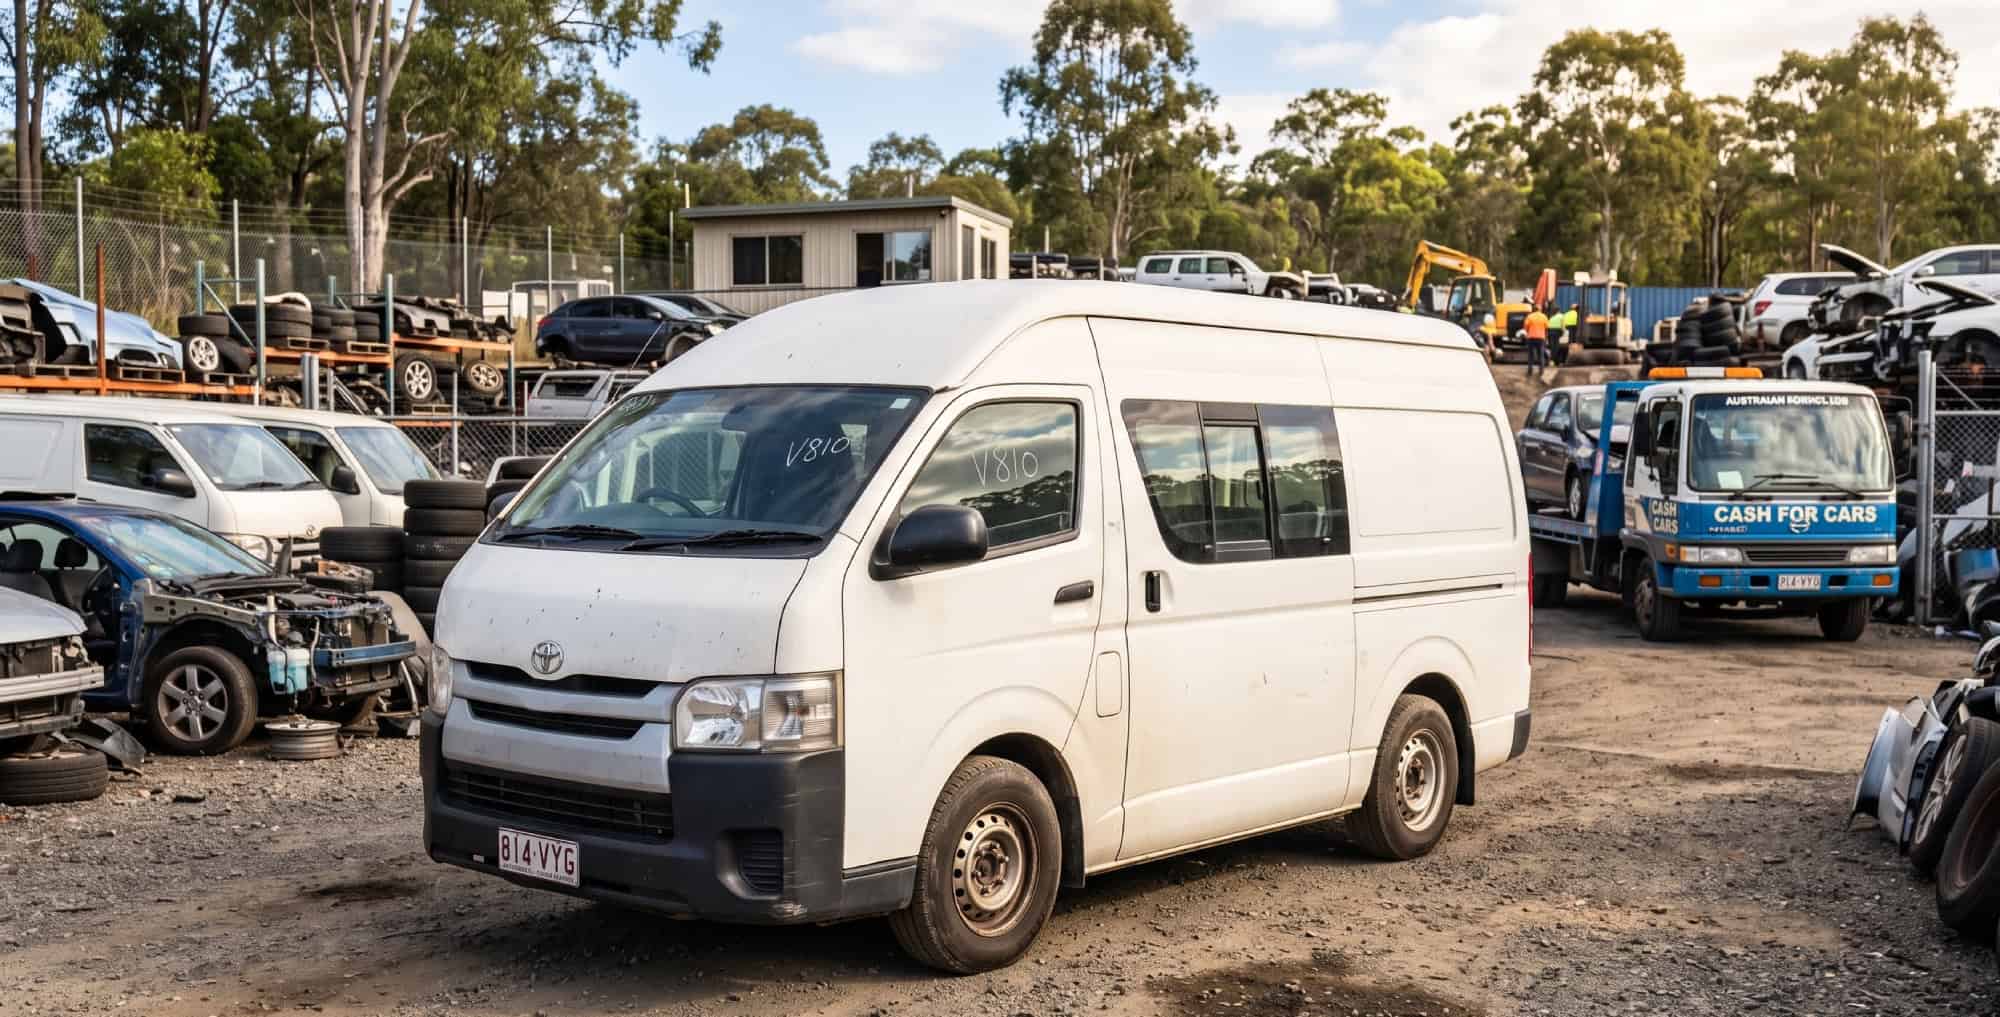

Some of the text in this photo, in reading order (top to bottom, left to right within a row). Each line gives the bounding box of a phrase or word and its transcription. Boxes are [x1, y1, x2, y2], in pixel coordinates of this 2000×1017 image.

[786, 437, 850, 467] V810
[970, 447, 1039, 489] V810
[1651, 500, 1678, 517] CASH
[1714, 505, 1878, 523] CASH FOR CARS
[1653, 517, 1679, 535] CARS
